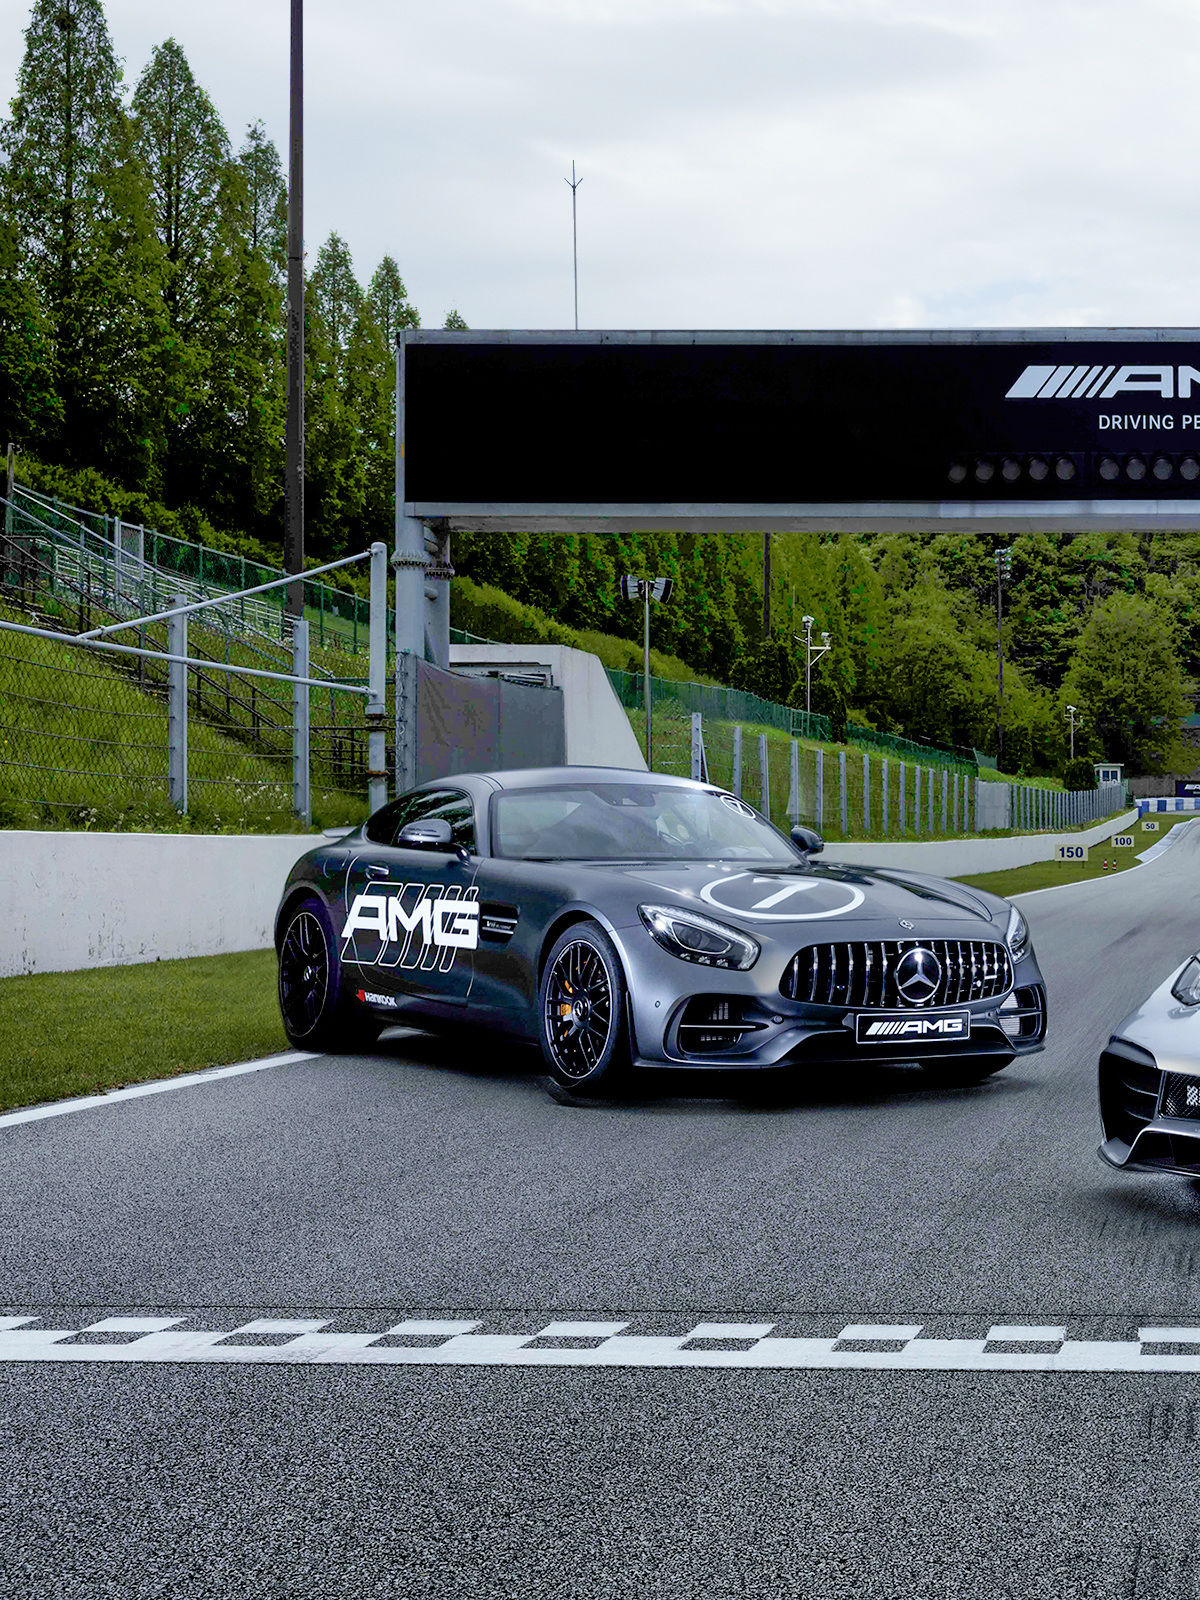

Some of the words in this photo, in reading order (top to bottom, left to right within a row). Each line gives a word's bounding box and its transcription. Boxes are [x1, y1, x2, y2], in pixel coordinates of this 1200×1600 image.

[1099, 414, 1174, 430] DRIVING
[1145, 822, 1156, 830] 50
[1114, 837, 1132, 846] 100
[1059, 846, 1084, 858] 150
[341, 894, 480, 950] AMG
[899, 1018, 963, 1035] AMG
